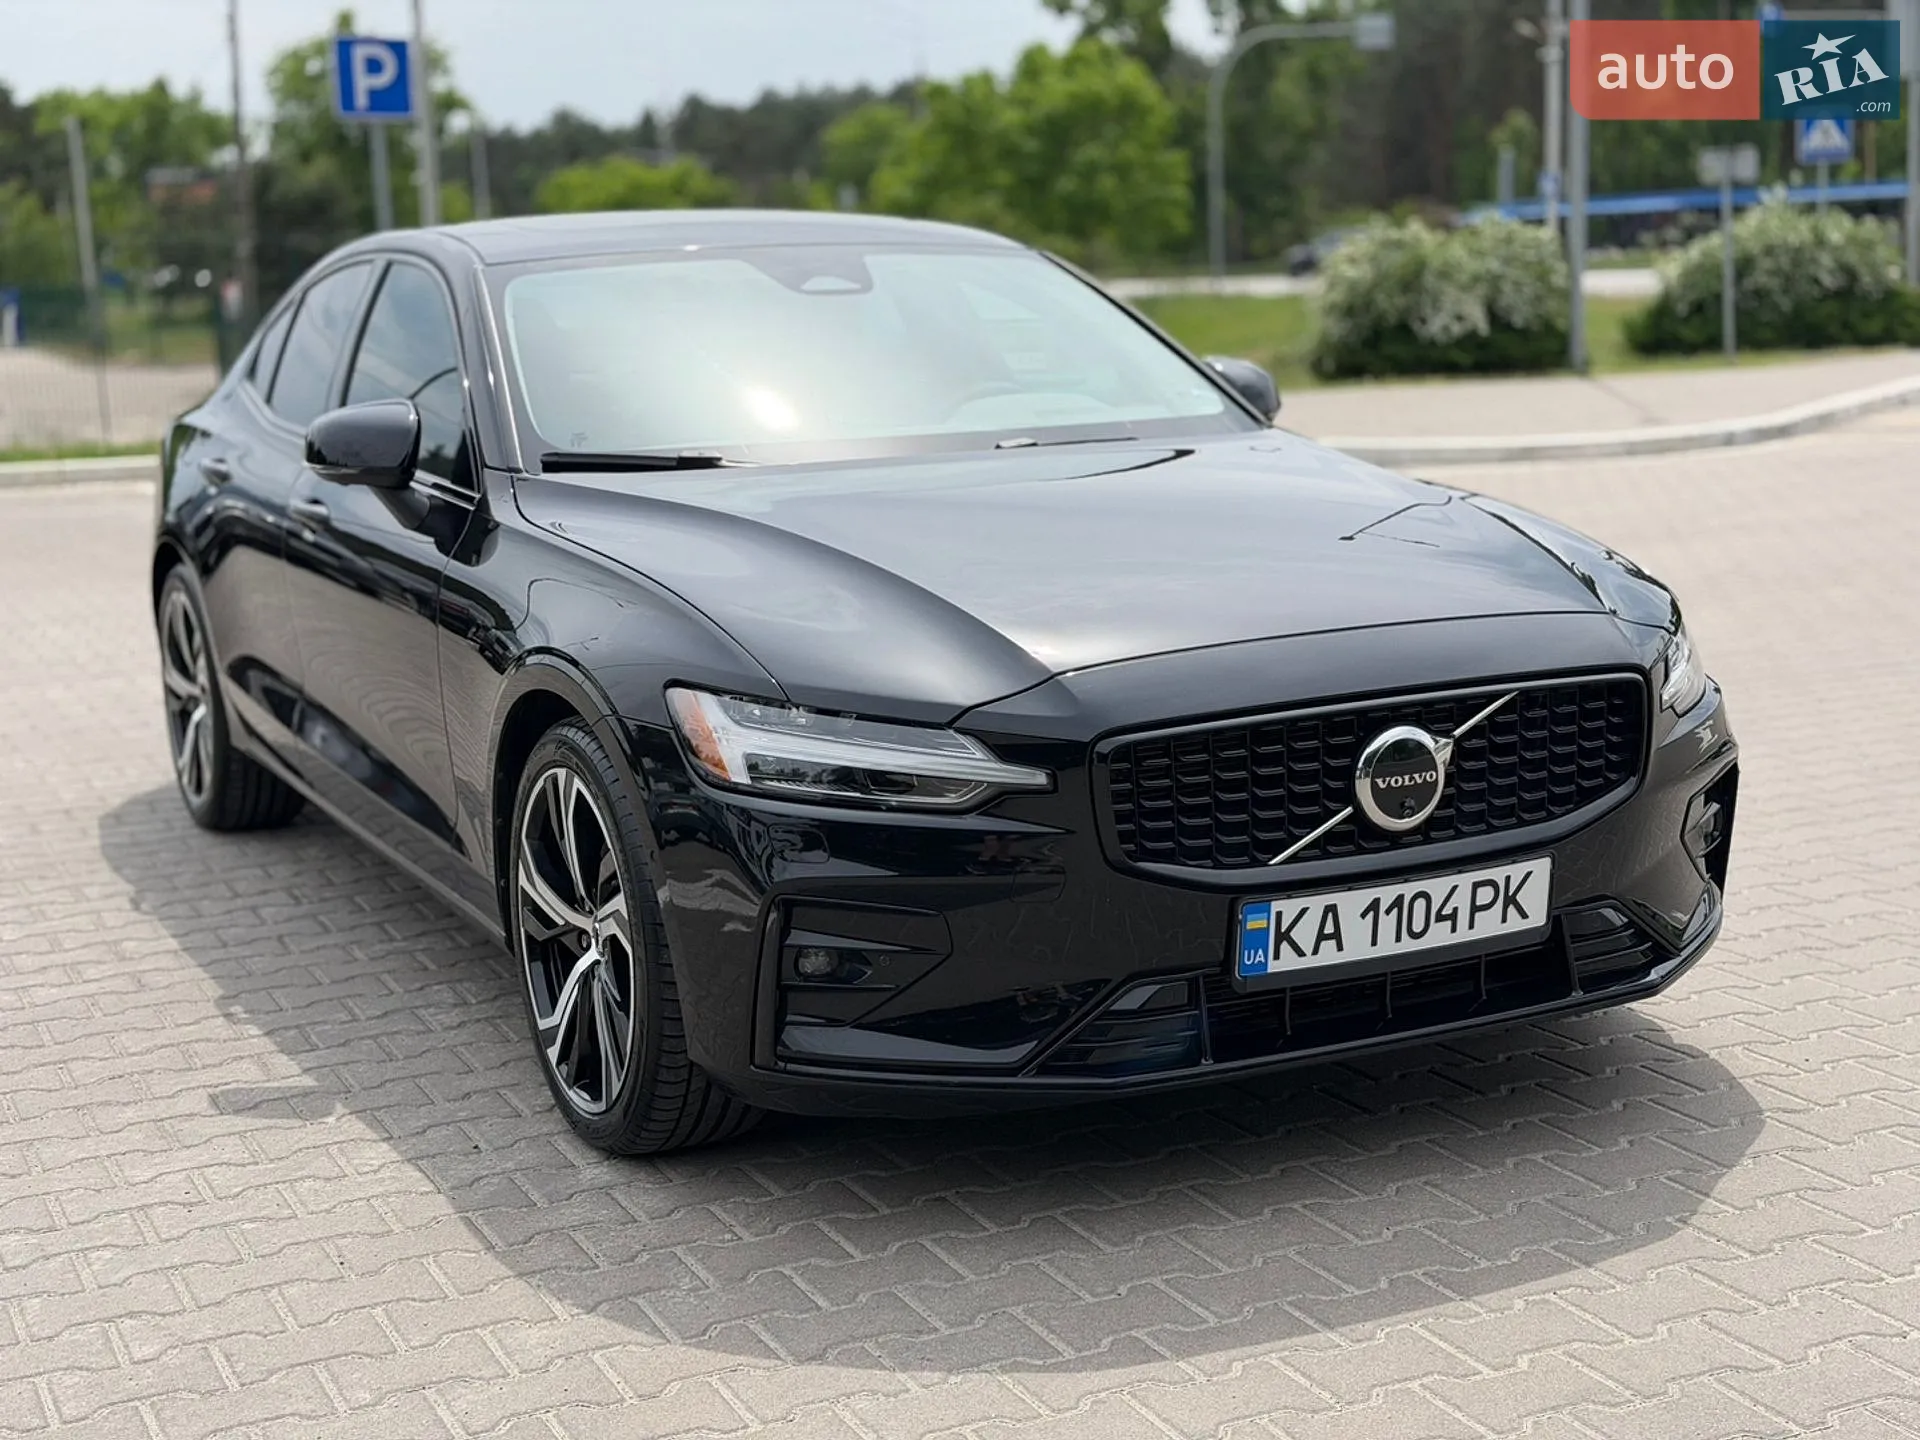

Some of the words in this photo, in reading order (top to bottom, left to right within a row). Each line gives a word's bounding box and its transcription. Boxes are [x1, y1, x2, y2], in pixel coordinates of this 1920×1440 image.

[350, 42, 399, 112] P
[1374, 770, 1437, 789] VOLVO
[1272, 902, 1345, 962] KA
[1243, 947, 1266, 966] UA
